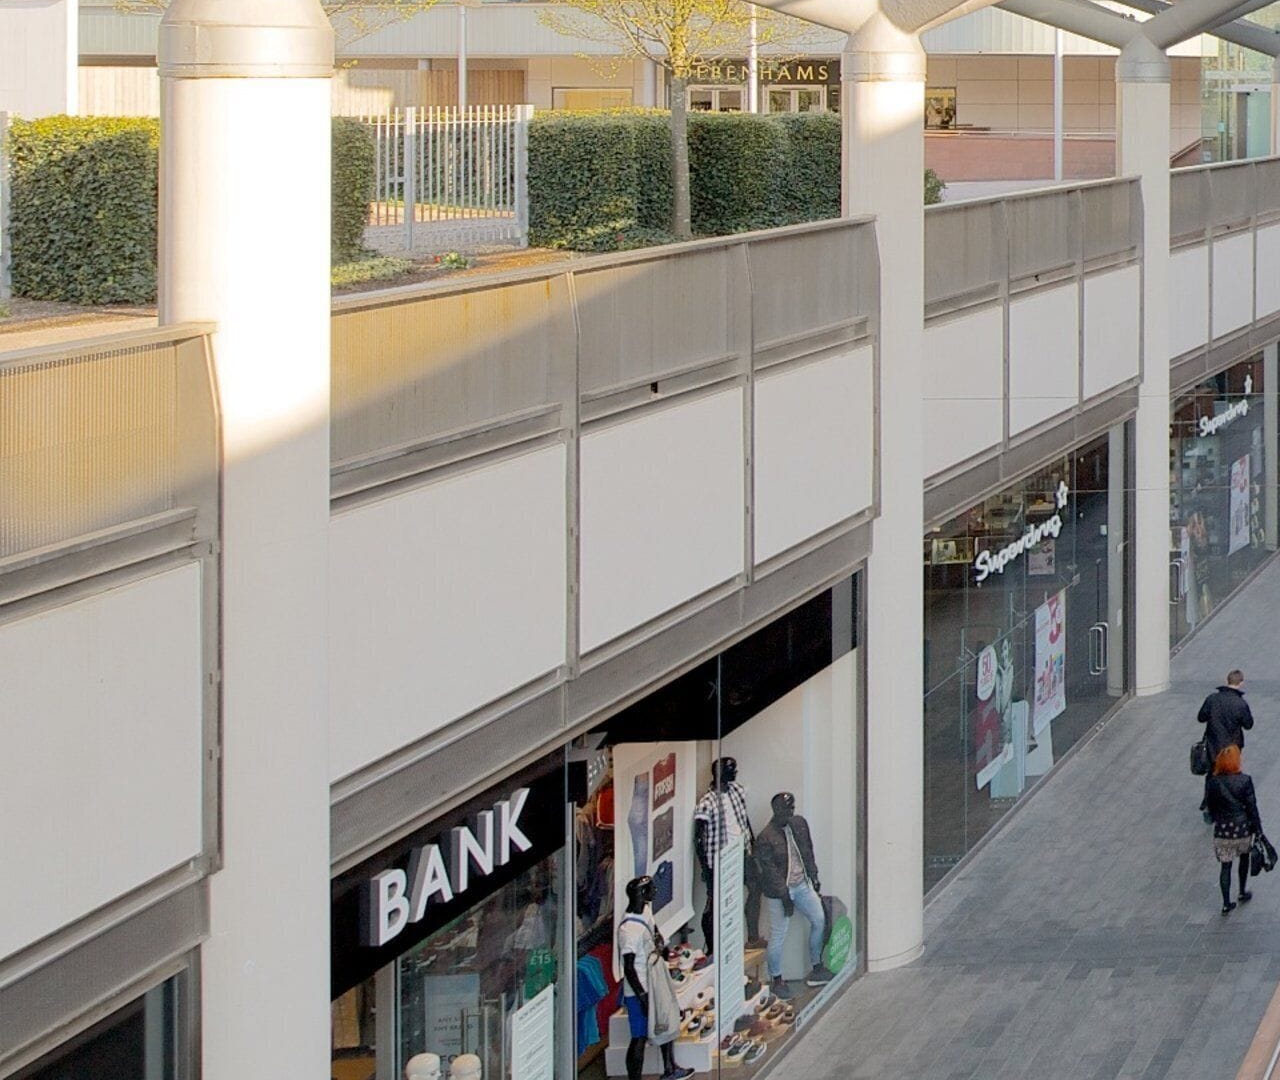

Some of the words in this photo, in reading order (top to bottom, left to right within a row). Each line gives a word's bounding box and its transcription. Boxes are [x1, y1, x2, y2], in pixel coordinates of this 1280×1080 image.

[1199, 399, 1249, 437] Superdrug
[975, 514, 1062, 583] Superdrug
[370, 787, 533, 948] BANK
